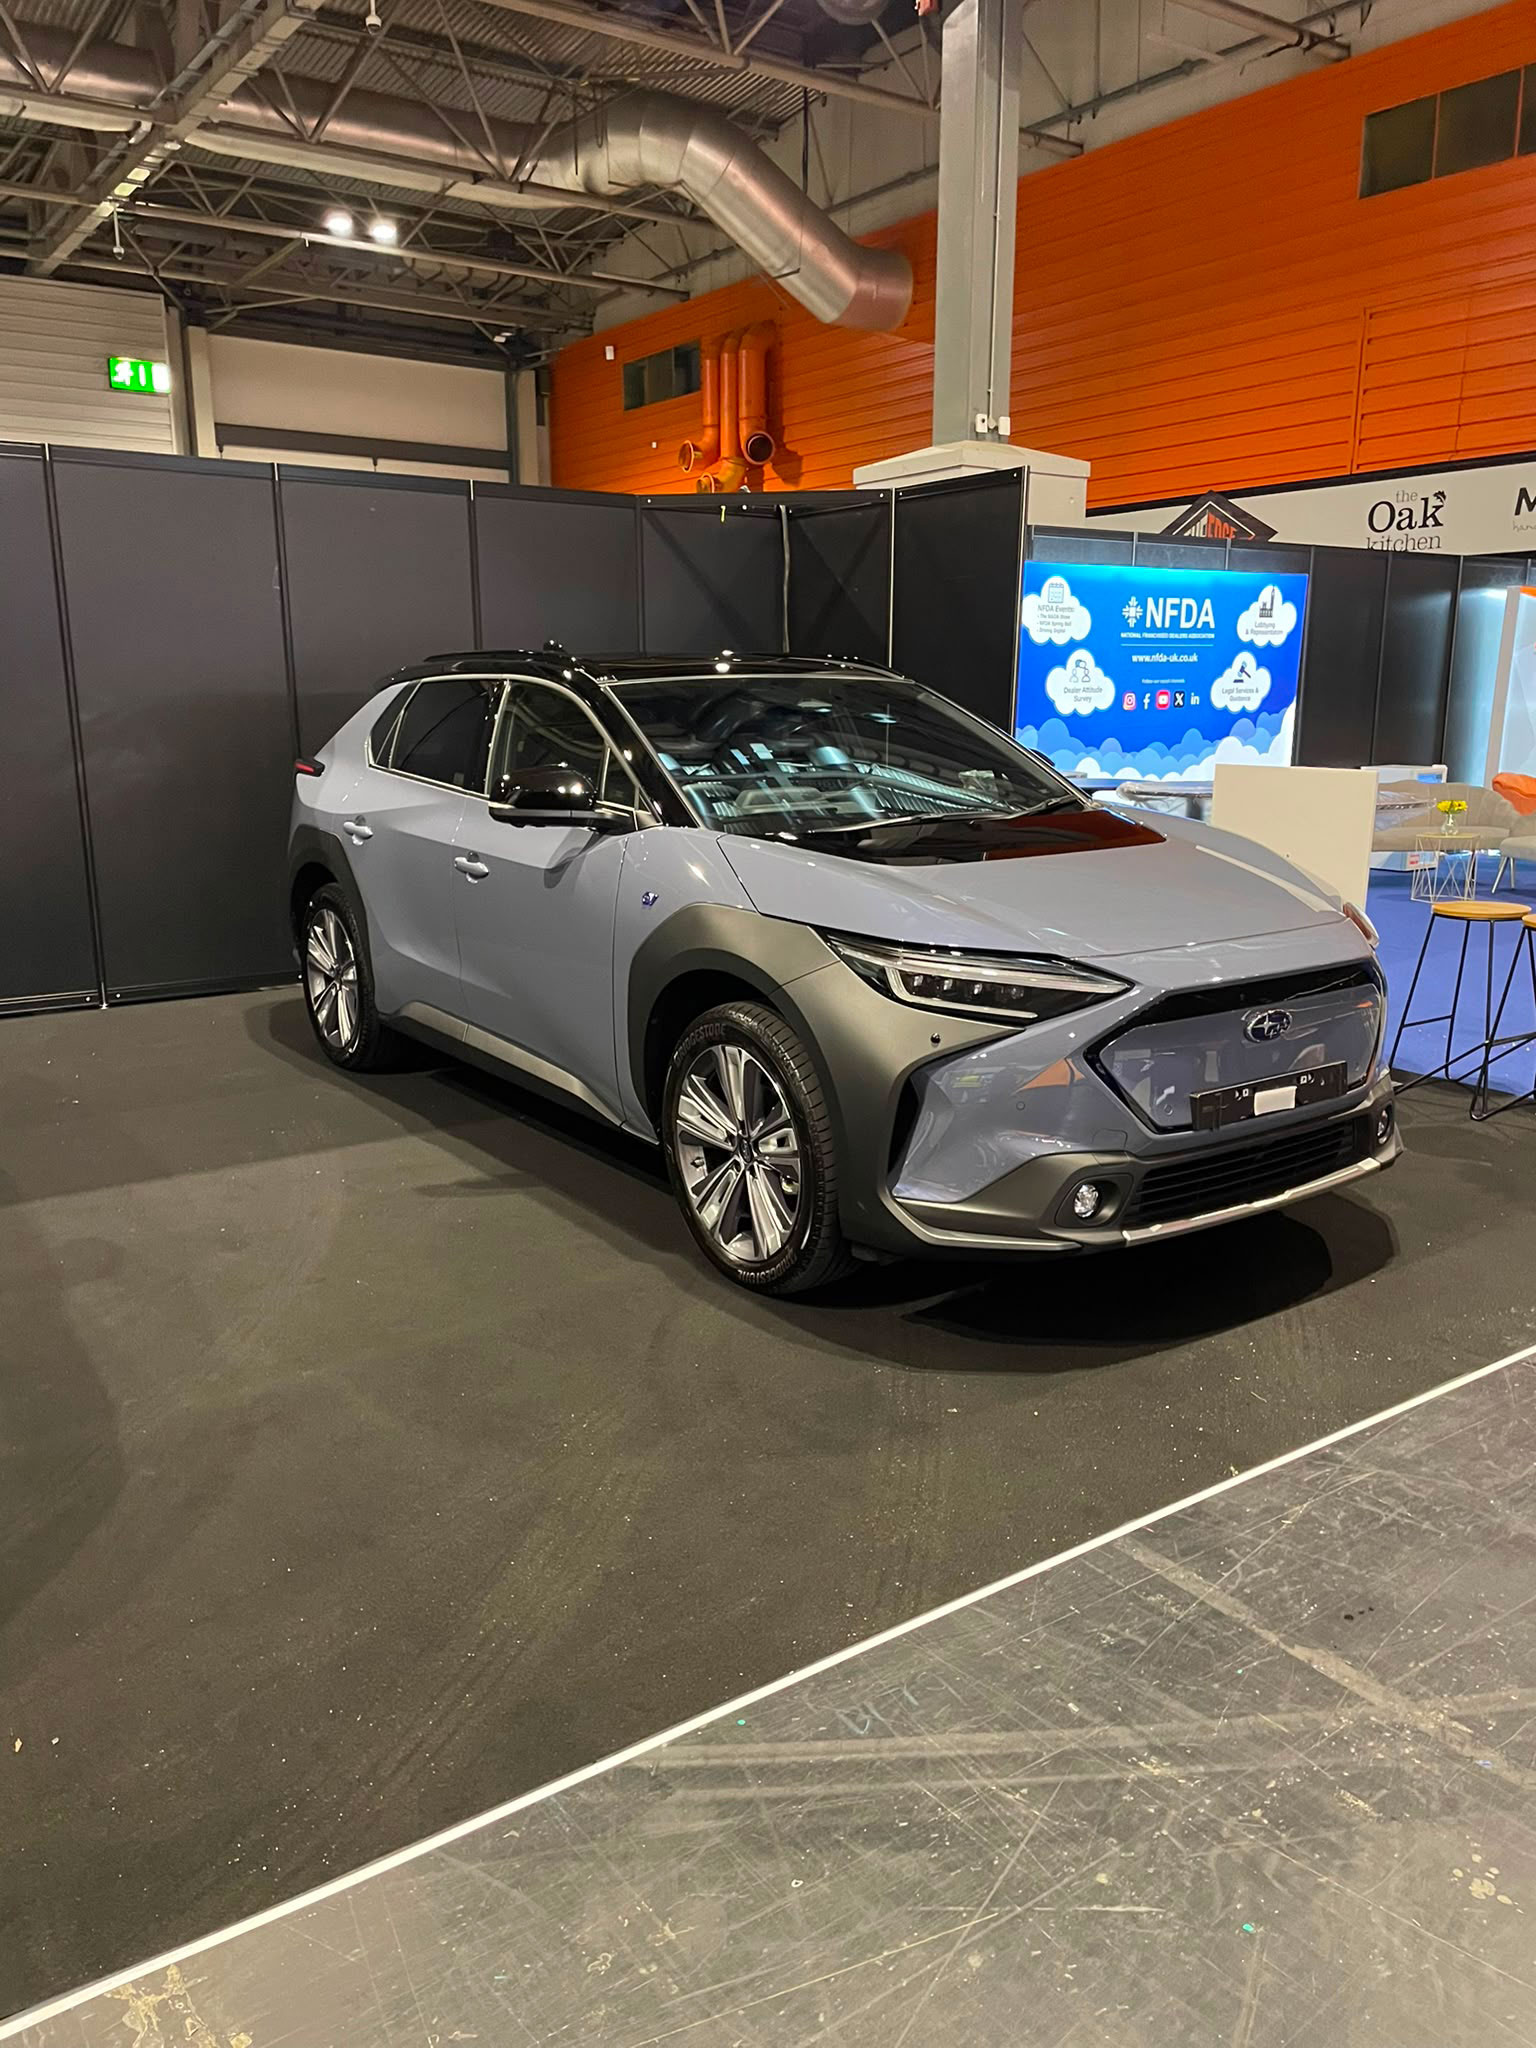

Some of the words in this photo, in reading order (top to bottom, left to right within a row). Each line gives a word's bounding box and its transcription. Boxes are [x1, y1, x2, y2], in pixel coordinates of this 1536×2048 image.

[1396, 489, 1418, 503] the
[1367, 496, 1444, 533] Oak
[1366, 533, 1442, 552] kitchen
[1145, 597, 1216, 629] NFDA
[1131, 652, 1199, 663] www.nfda-uk.co.uk
[1063, 686, 1082, 694] Dealer
[1082, 686, 1103, 694] Attitude
[1221, 687, 1235, 695] Legal
[1073, 694, 1093, 703] Survey
